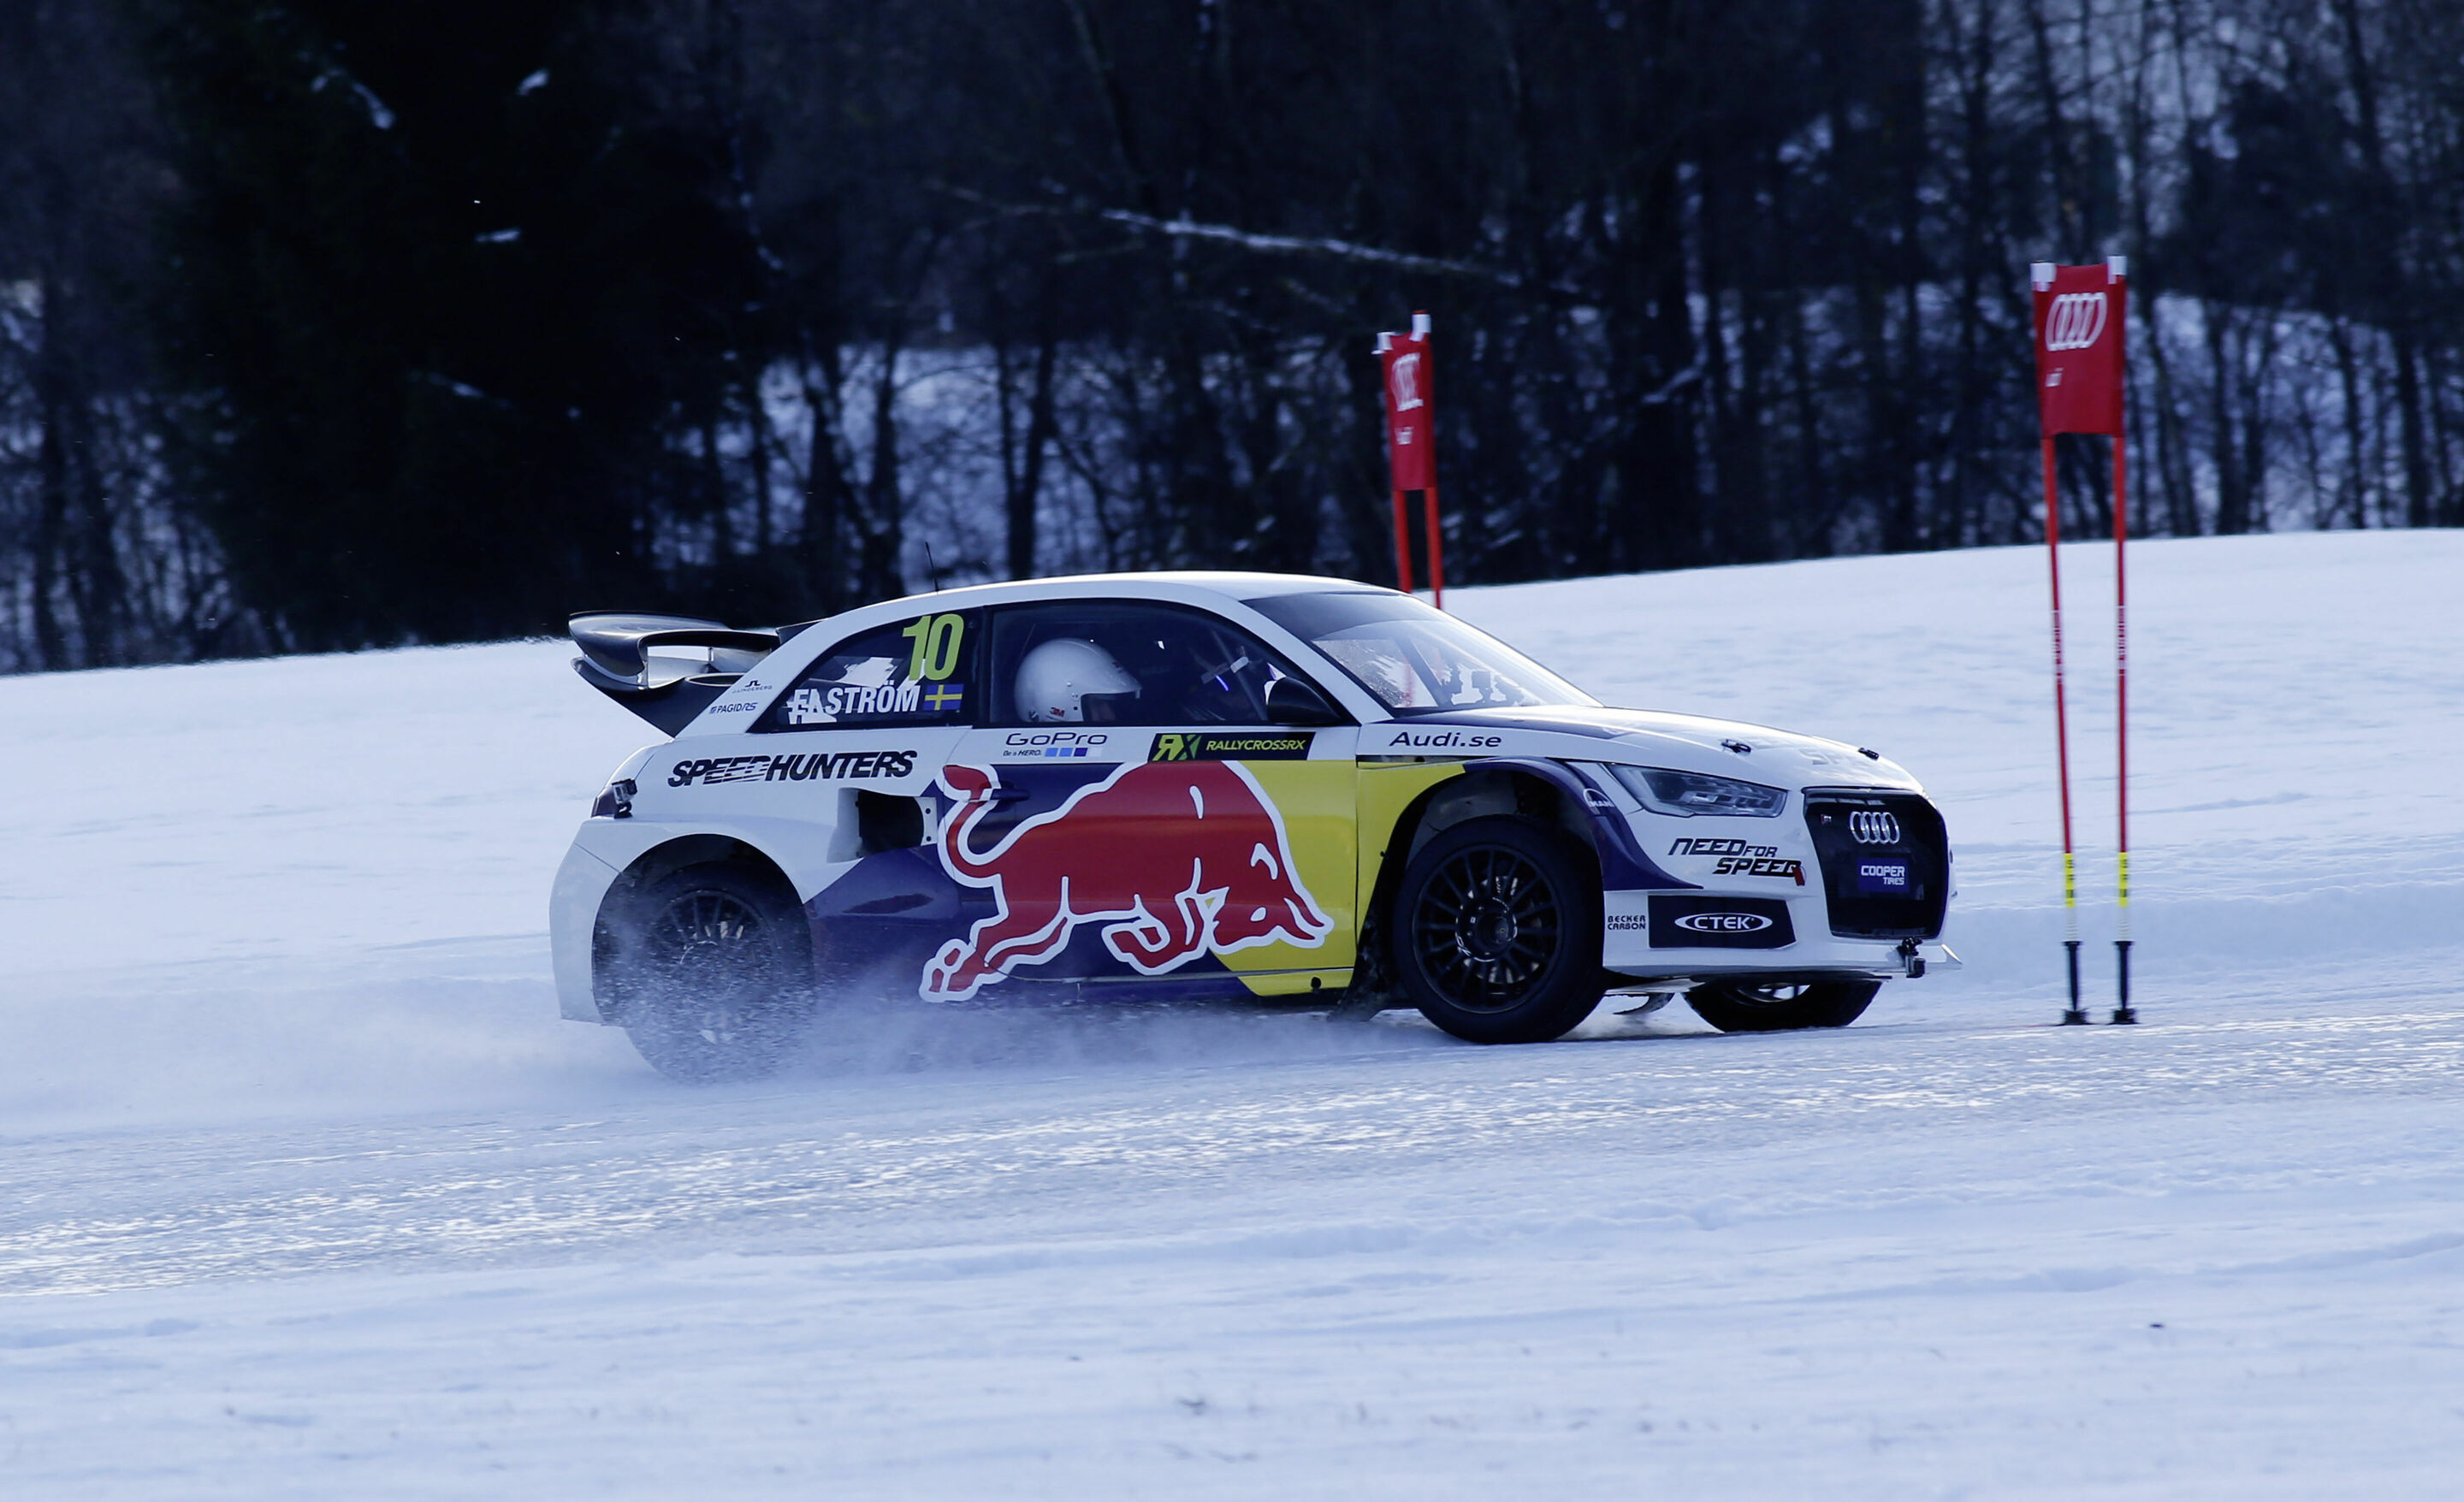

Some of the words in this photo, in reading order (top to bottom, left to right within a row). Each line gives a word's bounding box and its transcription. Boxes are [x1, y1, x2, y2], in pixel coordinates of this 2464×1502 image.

[902, 613, 964, 681] 10
[1005, 732, 1108, 746] GoPro
[1205, 740, 1307, 751] RALLYCROSSRX
[1389, 731, 1502, 748] Audi.se
[667, 750, 918, 788] SPEEDHUNTERS
[1667, 837, 1747, 856] NEED
[1742, 845, 1779, 858] FOR
[1861, 865, 1905, 877] COOPER
[1883, 877, 1904, 885] TIRES
[1693, 916, 1751, 930] CTEK
